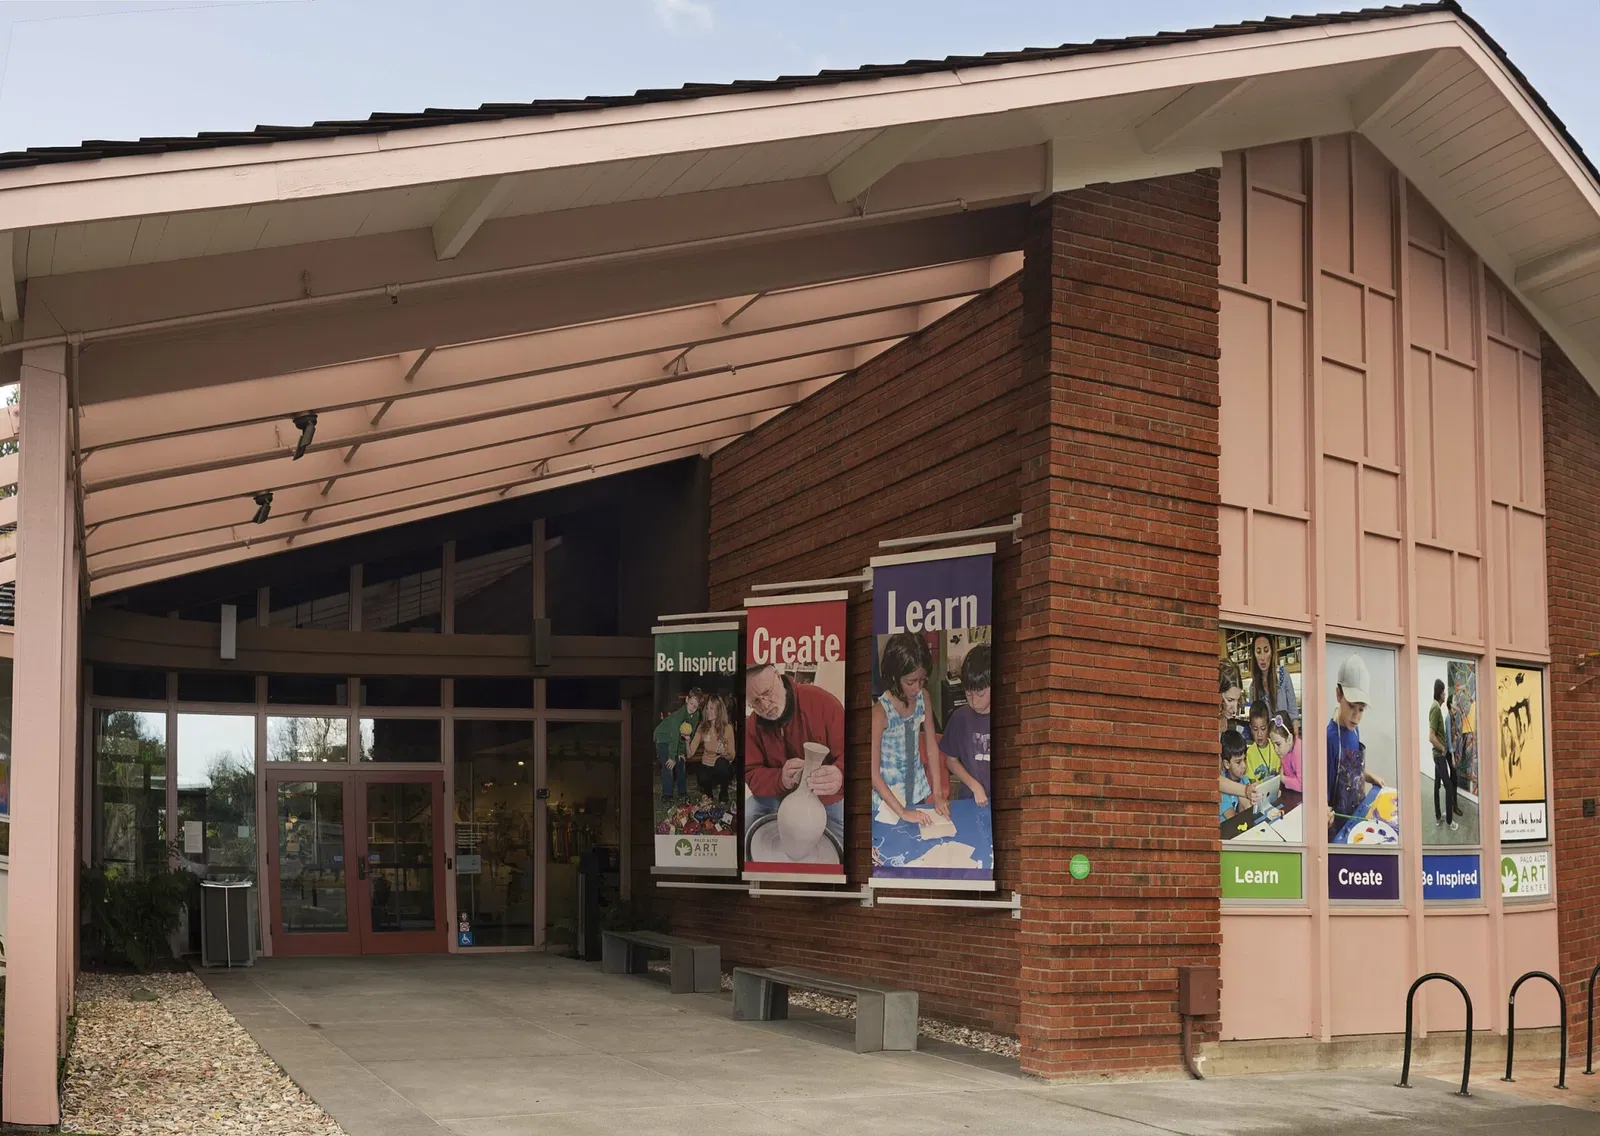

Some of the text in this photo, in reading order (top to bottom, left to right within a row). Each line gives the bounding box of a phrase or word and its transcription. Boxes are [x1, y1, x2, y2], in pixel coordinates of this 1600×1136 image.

[888, 590, 978, 635] Learn
[753, 625, 840, 665] Create
[656, 650, 736, 677] Be Inspired
[1519, 812, 1528, 825] the
[1530, 809, 1542, 824] hand
[694, 843, 718, 852] ART
[1534, 855, 1546, 863] ALTO
[1235, 866, 1279, 884] Learn
[1338, 868, 1383, 886] Create
[1422, 869, 1478, 889] Be Inspired
[1521, 864, 1546, 882] ART
[1521, 884, 1547, 892] CENTER
